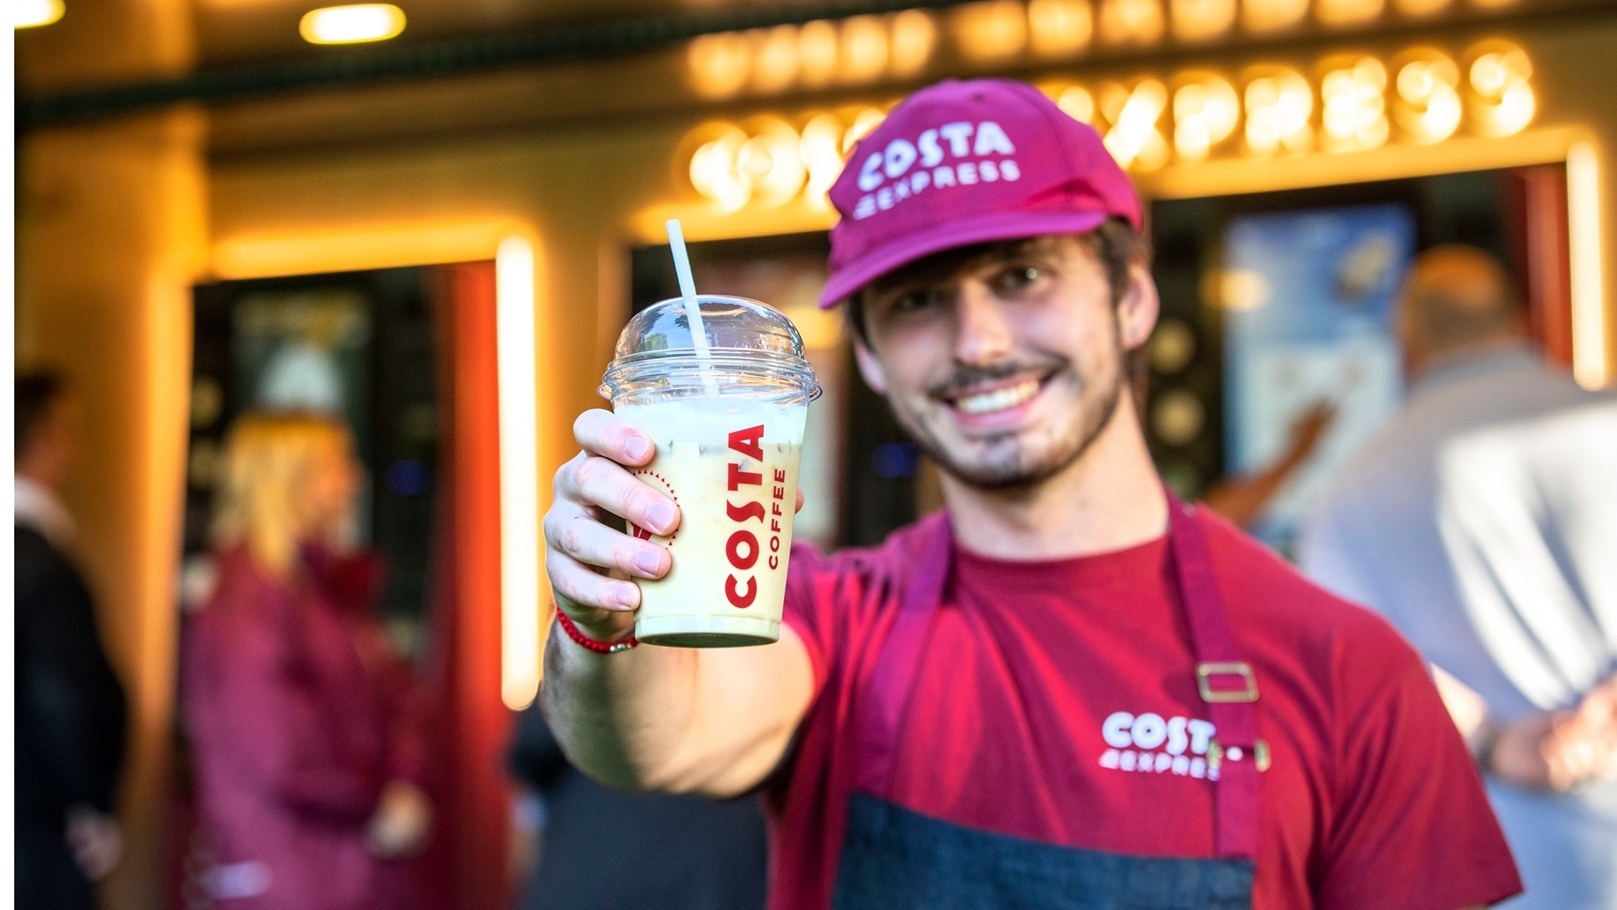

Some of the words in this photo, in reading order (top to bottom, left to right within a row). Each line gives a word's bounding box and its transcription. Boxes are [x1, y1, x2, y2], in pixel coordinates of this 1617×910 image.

[857, 121, 1016, 192] COSTA
[876, 159, 1021, 211] EXPRESS
[724, 424, 766, 609] COSTA
[768, 468, 787, 571] COFFEE
[1102, 711, 1217, 757] COST
